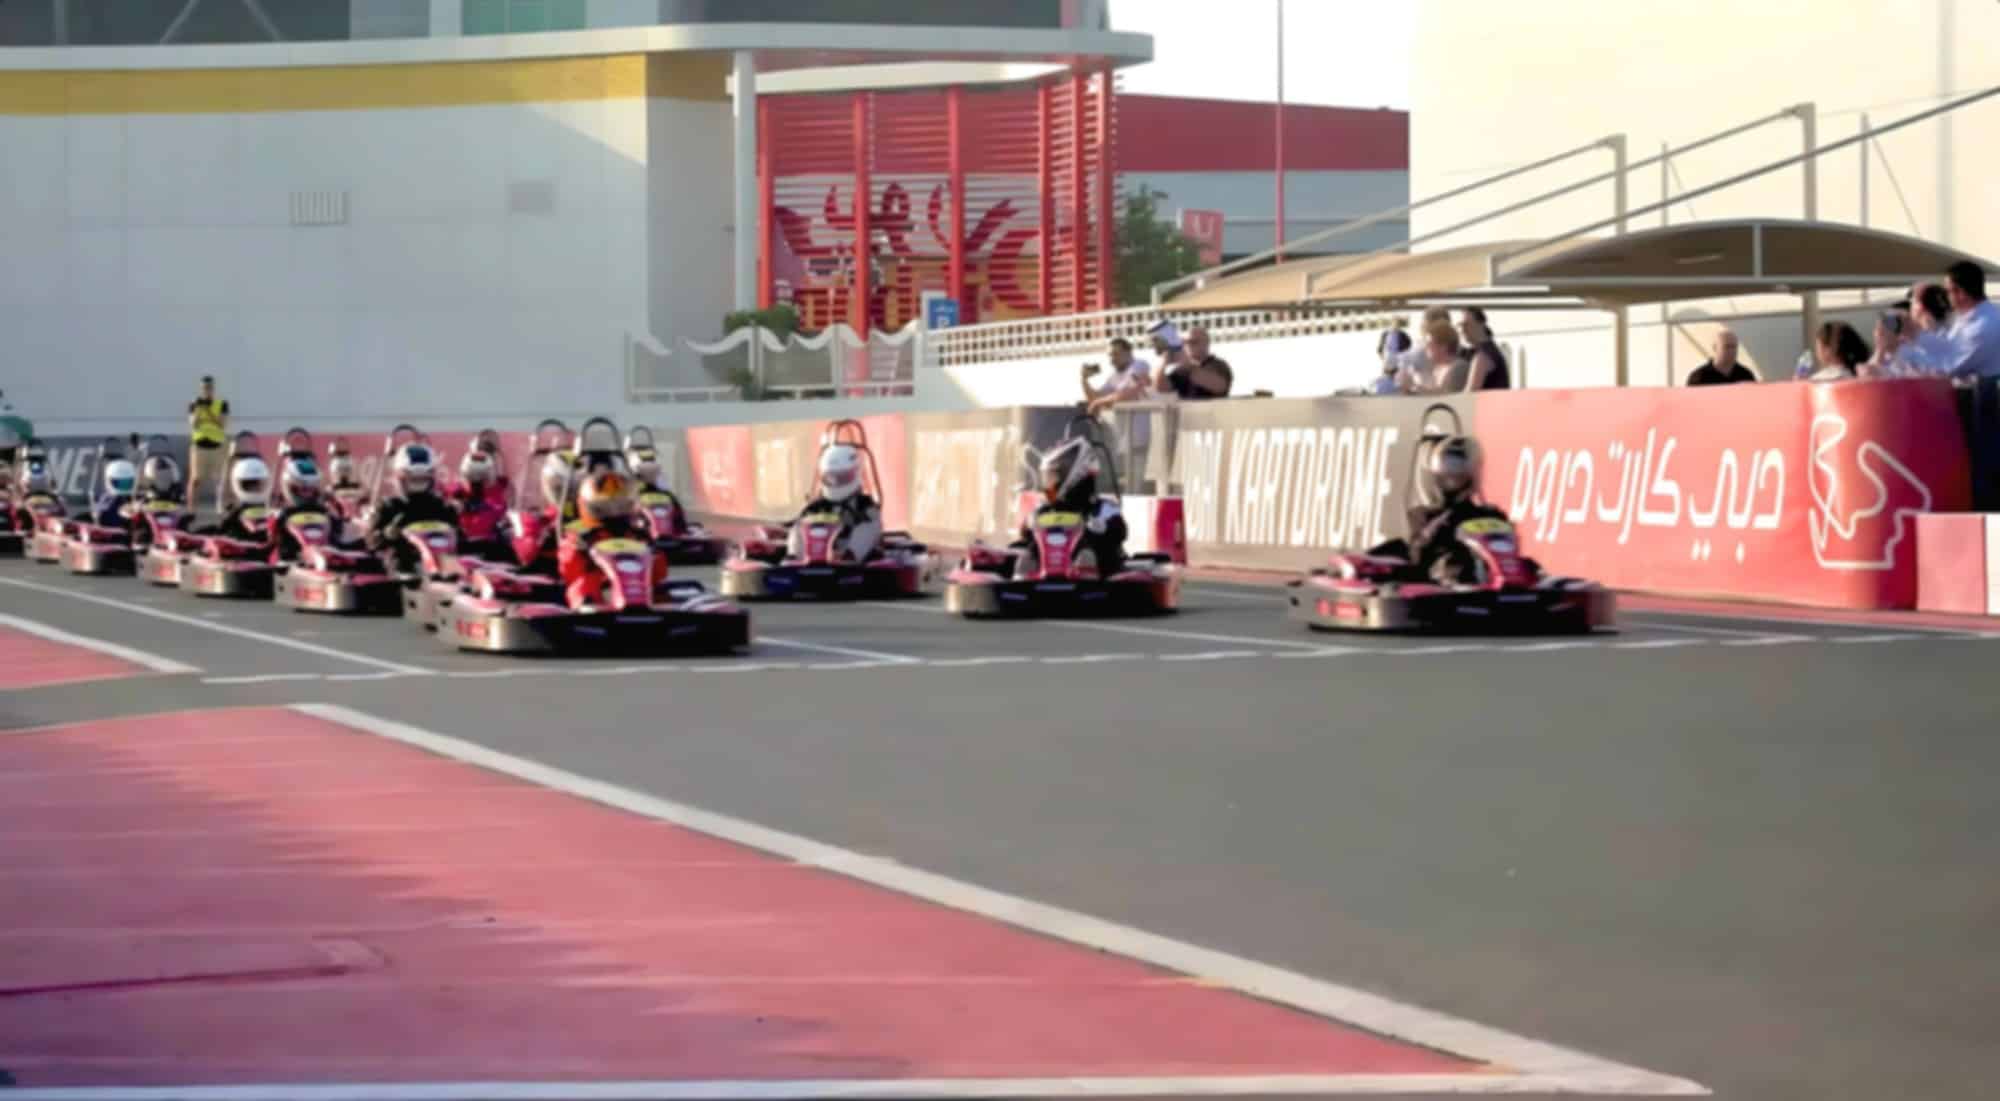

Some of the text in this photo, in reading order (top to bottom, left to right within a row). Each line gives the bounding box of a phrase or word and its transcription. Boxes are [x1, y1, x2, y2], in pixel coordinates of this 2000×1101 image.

[1224, 426, 1399, 549] KARTDROME
[1510, 425, 1785, 565] دبي كارت دروم
